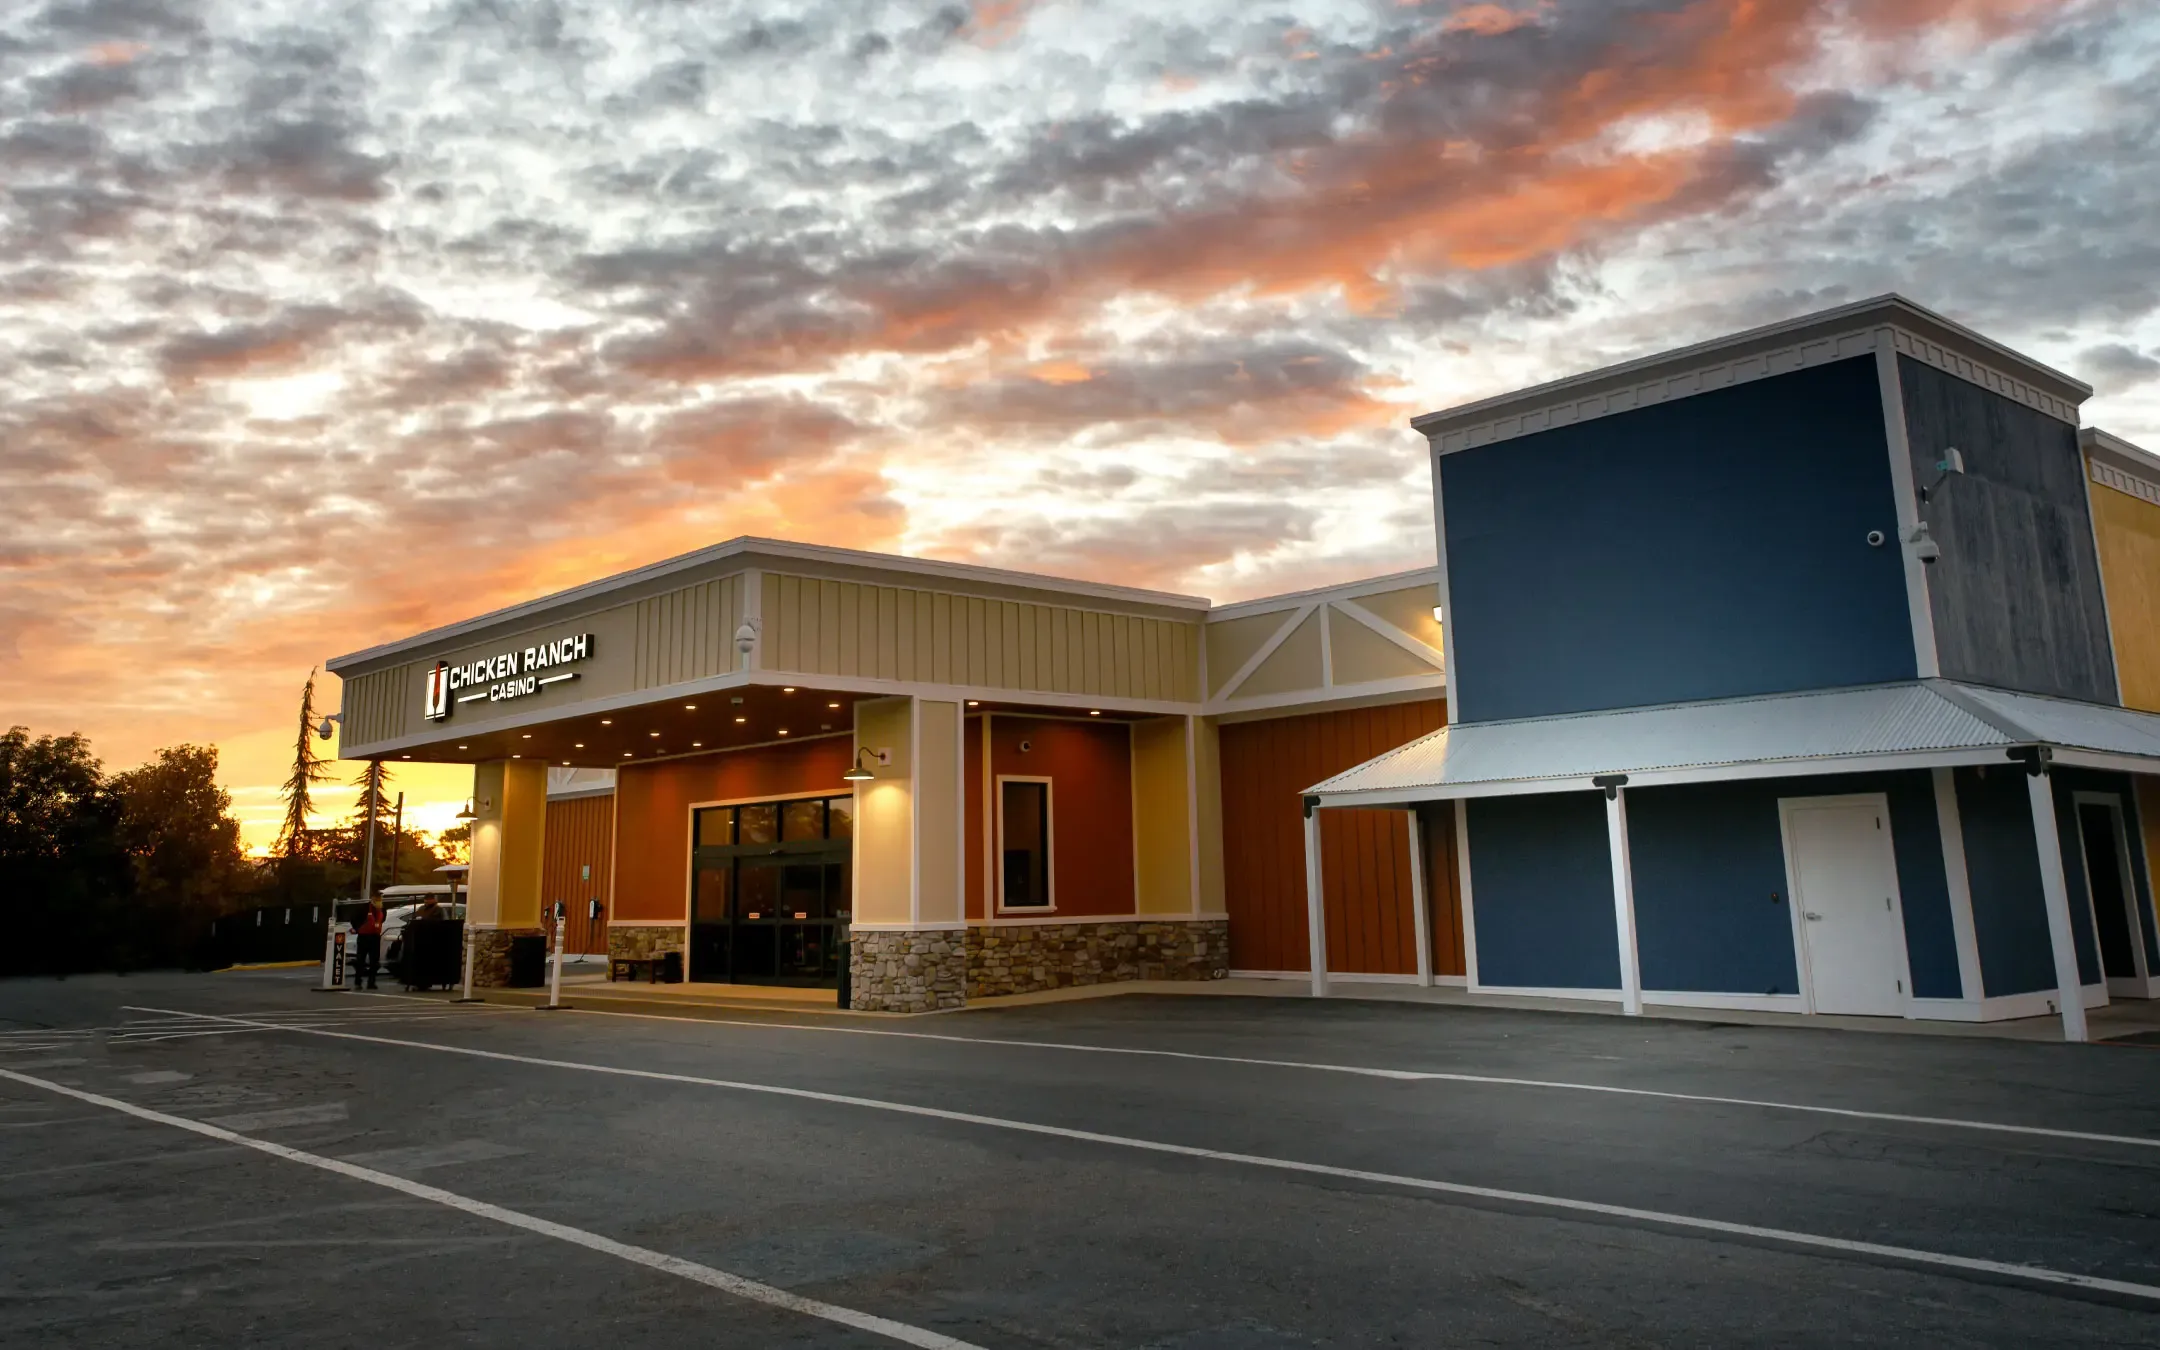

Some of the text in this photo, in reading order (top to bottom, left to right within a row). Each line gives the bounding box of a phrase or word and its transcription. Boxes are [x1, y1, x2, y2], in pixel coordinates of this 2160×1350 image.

[450, 633, 587, 690] CHICKEN RANCH
[490, 676, 536, 702] CASINO
[335, 944, 343, 984] VALET
